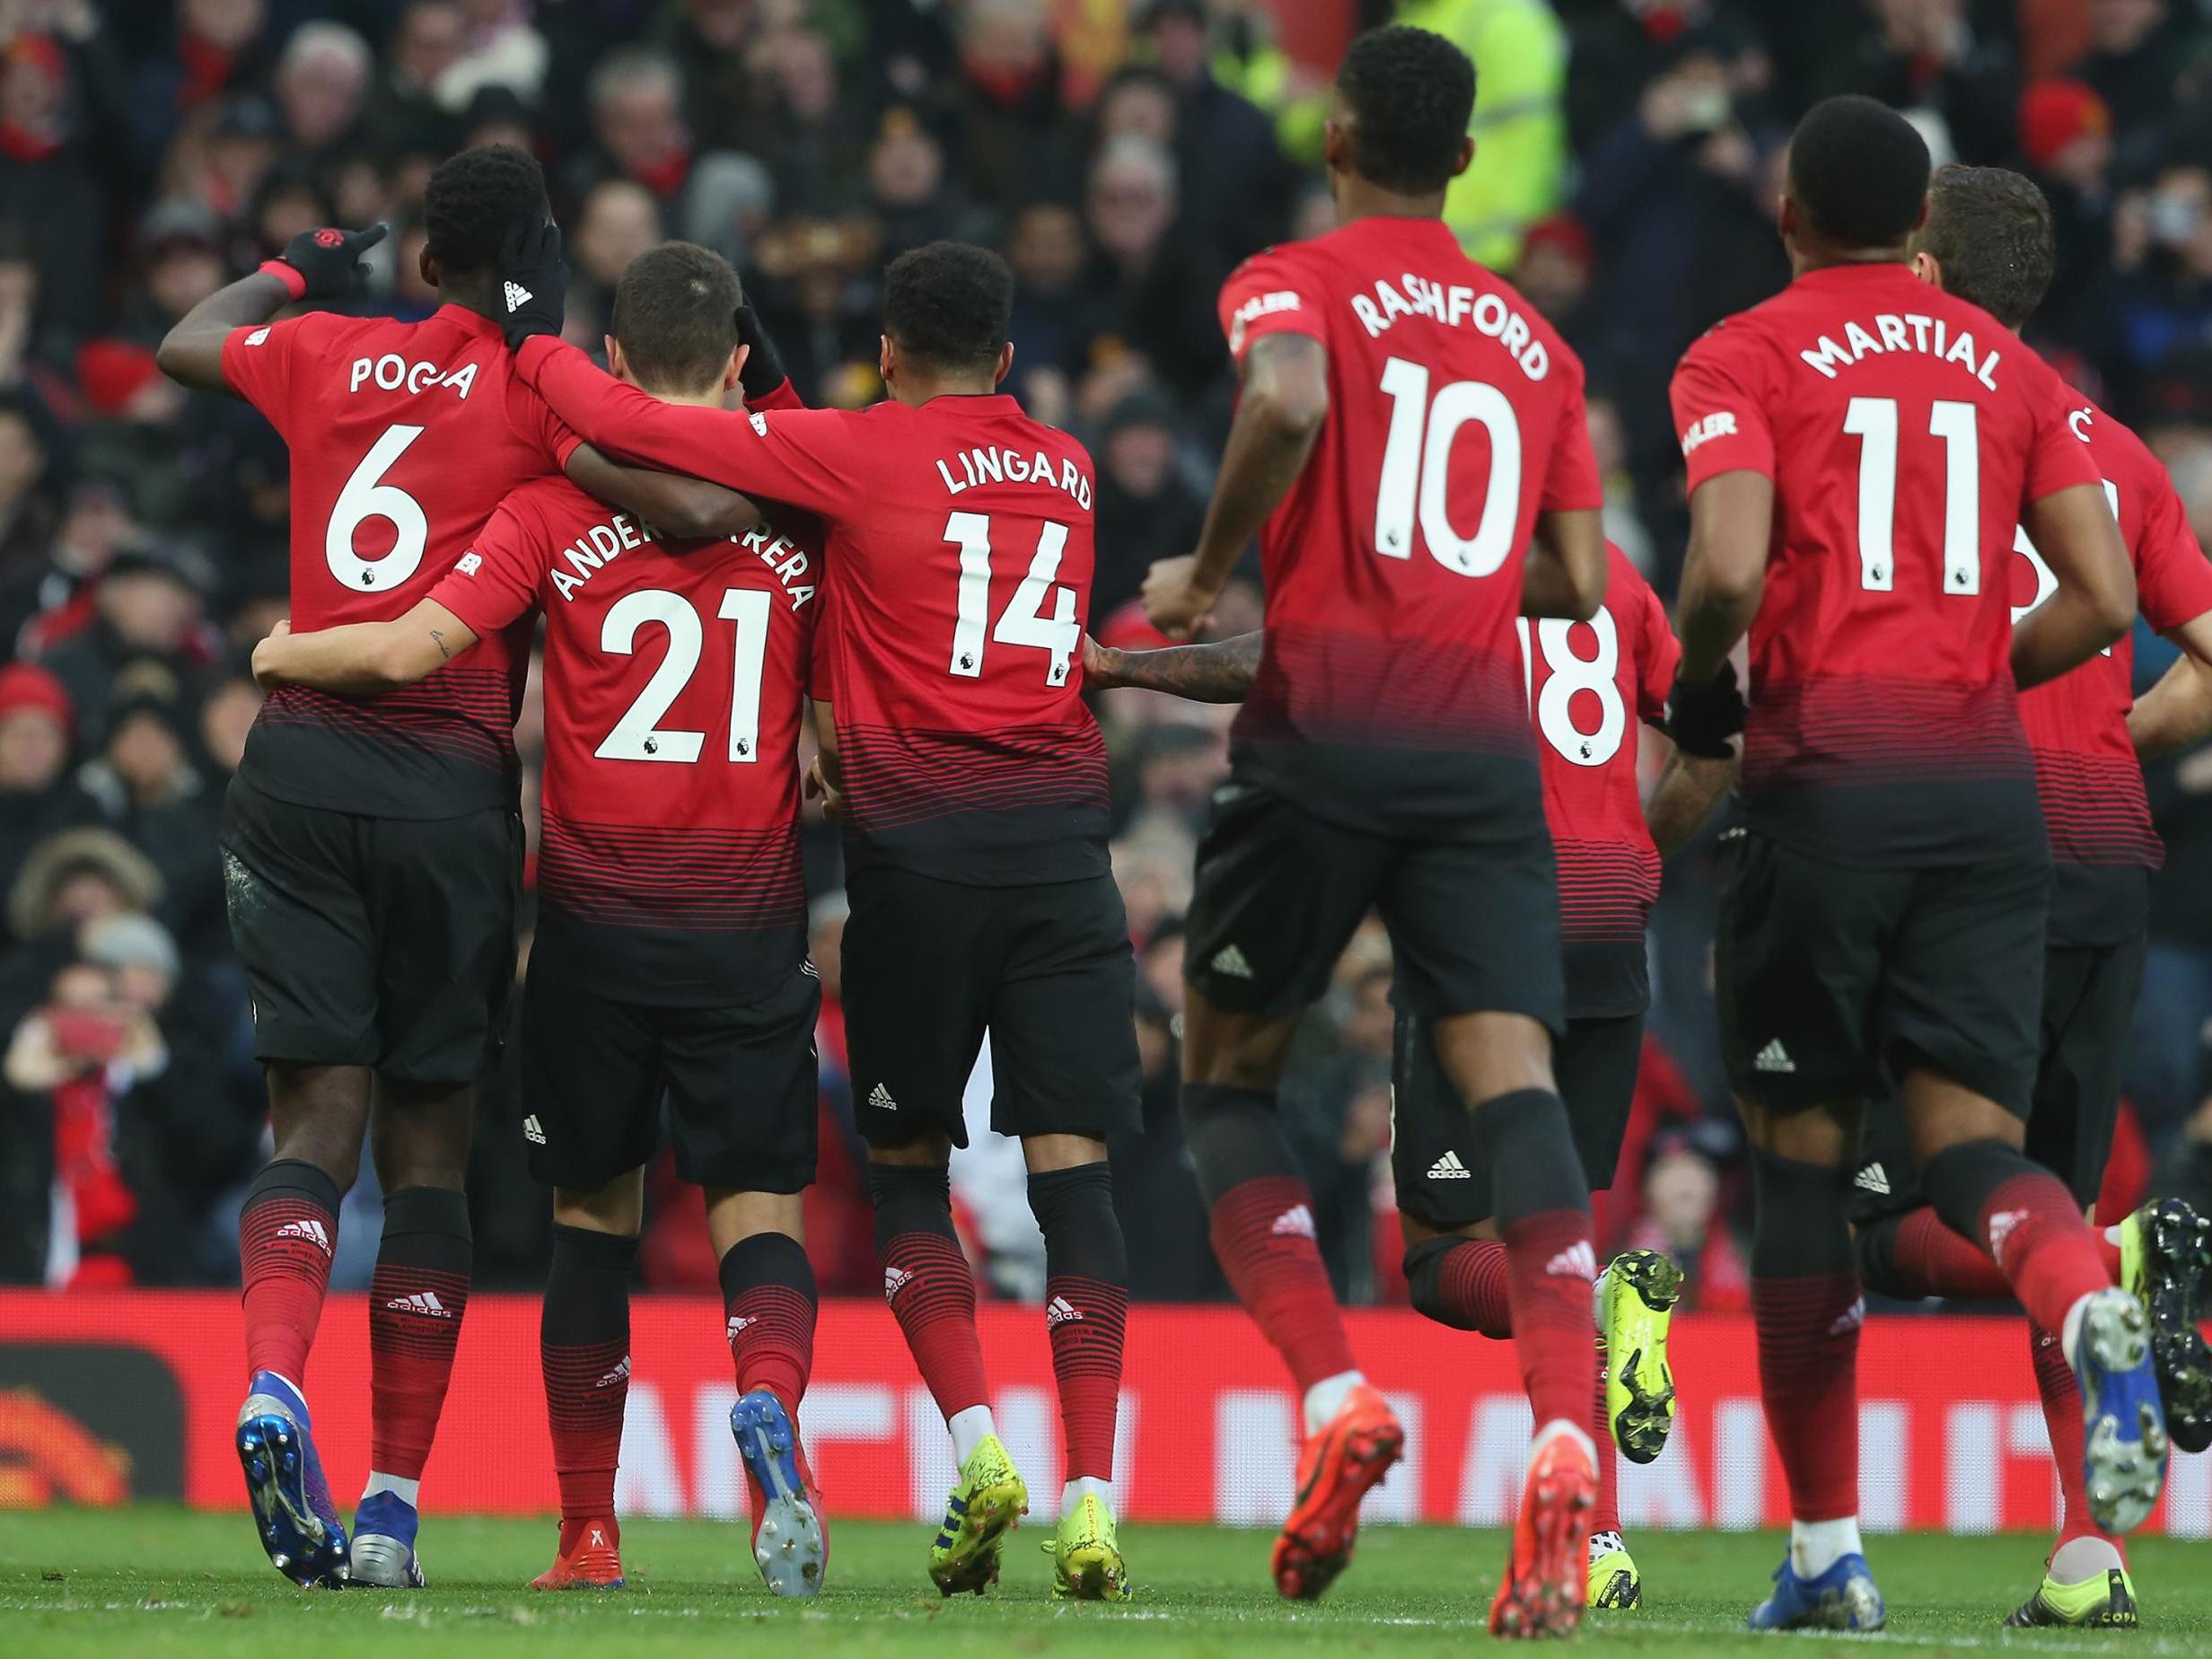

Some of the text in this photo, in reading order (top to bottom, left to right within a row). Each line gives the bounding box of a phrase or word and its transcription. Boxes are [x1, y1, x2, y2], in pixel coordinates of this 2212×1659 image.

[1350, 272, 1549, 382] RASHFORD
[1800, 312, 2001, 391] MARTIAL
[349, 353, 479, 400] POGA
[324, 423, 429, 593] 6
[935, 445, 1093, 512] LINGARD
[1374, 356, 1523, 578] 10
[1842, 396, 1981, 597] 11
[942, 510, 1082, 688] 14
[593, 587, 772, 764] 21
[1426, 1169, 1471, 1180] adidas
[276, 1228, 333, 1258] adidas
[386, 1301, 452, 1318] adidas
